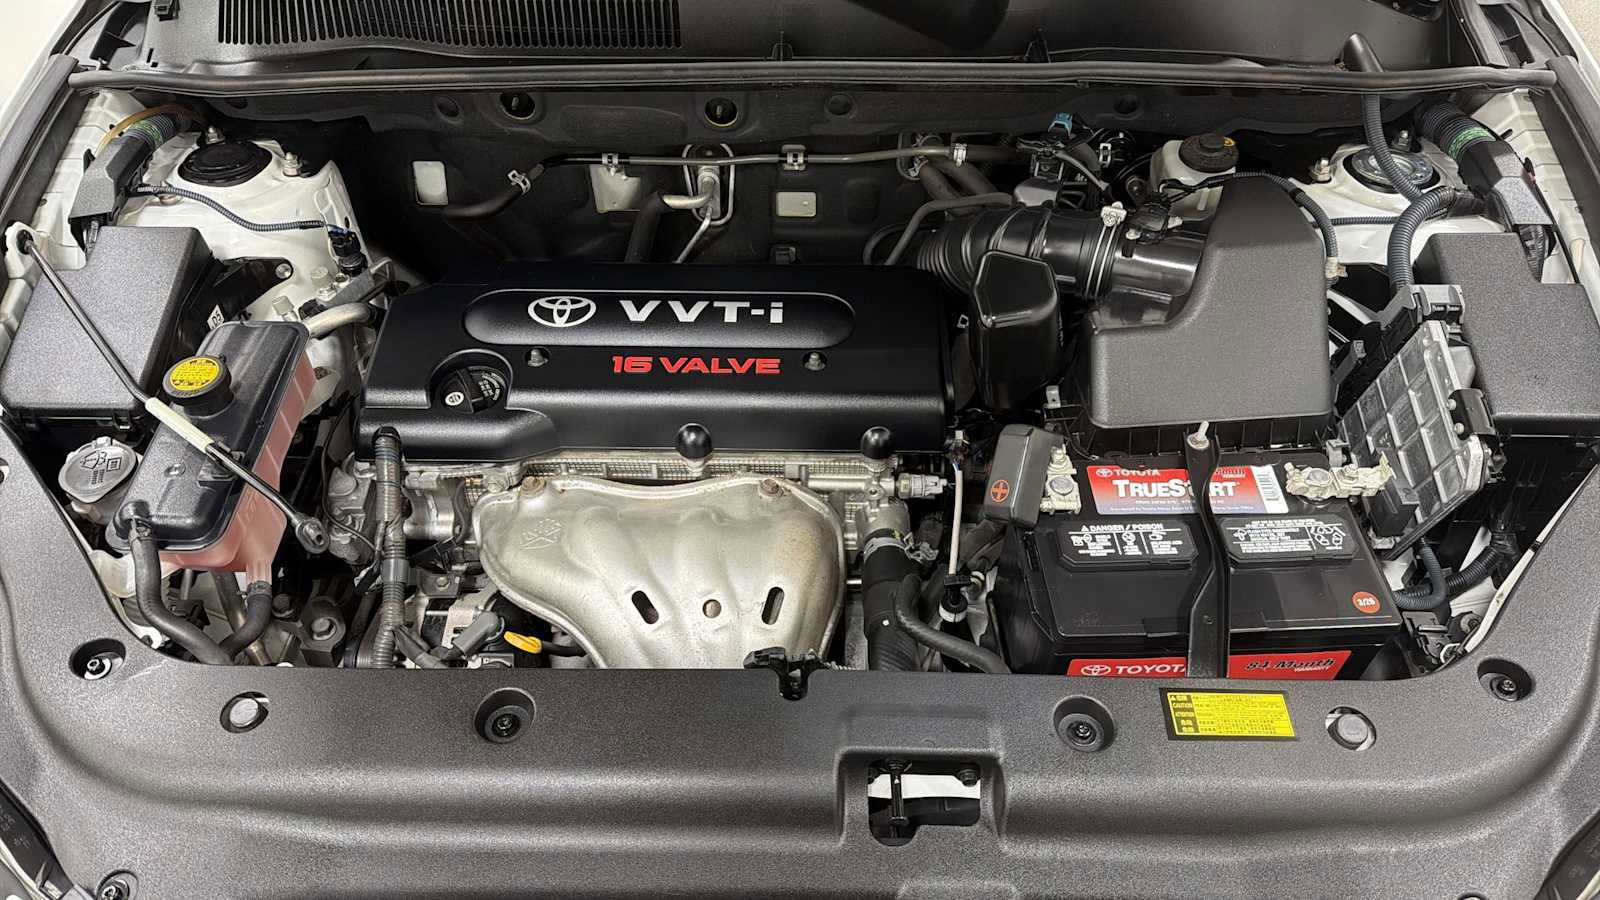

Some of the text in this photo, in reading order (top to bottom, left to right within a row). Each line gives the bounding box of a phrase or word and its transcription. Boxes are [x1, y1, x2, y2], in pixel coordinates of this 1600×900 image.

[620, 299, 784, 324] VVT-i
[612, 356, 781, 375] 16 VALVE
[1114, 468, 1161, 477] TOYOTA
[1132, 523, 1164, 531] POISON
[1115, 664, 1186, 674] TOYOT
[1246, 658, 1335, 671] 84 Month
